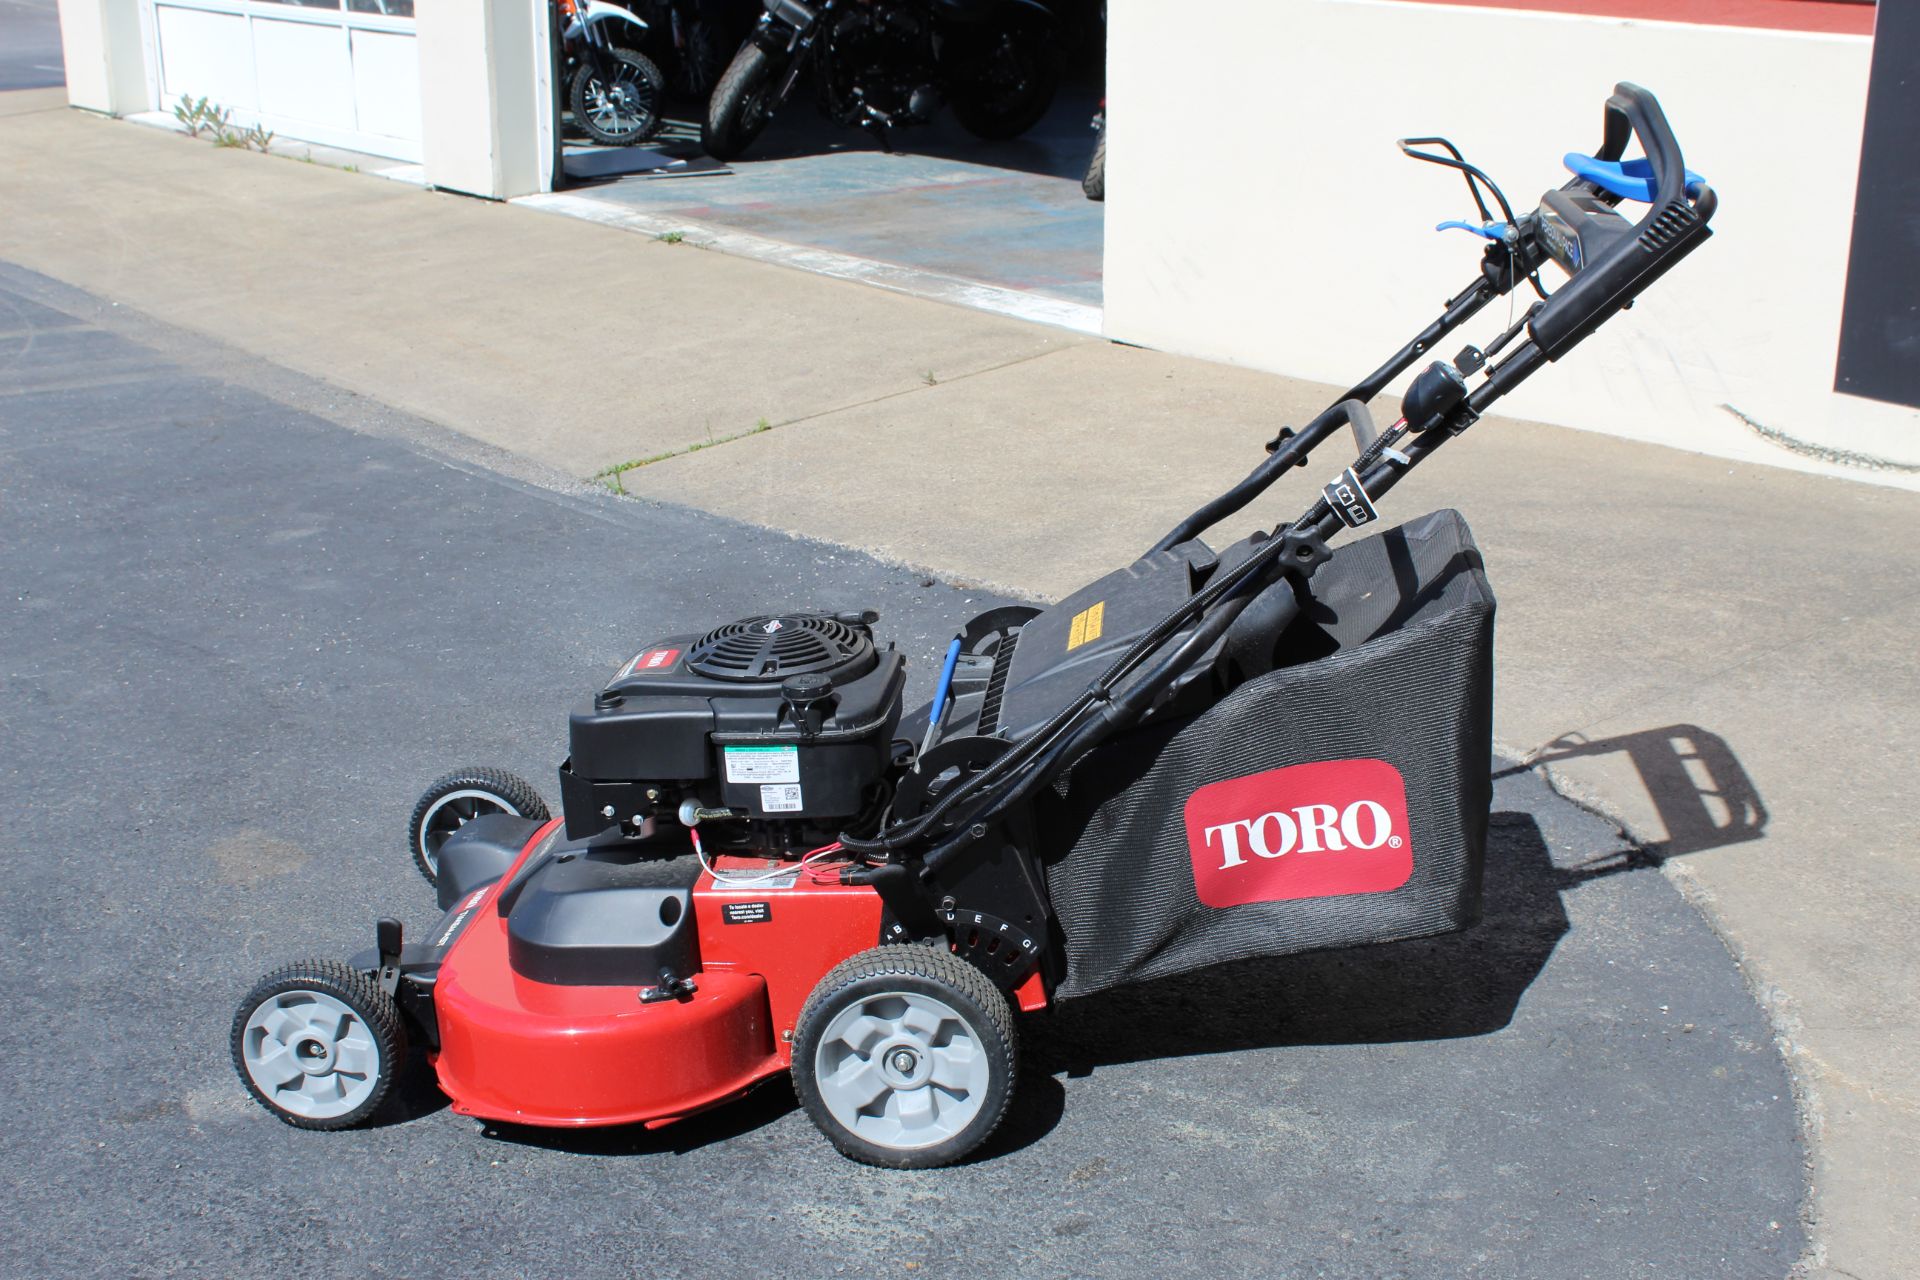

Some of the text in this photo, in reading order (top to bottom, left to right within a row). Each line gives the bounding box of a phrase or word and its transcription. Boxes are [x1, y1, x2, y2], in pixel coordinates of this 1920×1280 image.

[1205, 800, 1392, 870] TORO
[974, 914, 983, 924] E
[893, 924, 902, 934] B
[999, 923, 1009, 932] F
[886, 933, 893, 941] A
[1022, 939, 1032, 948] G
